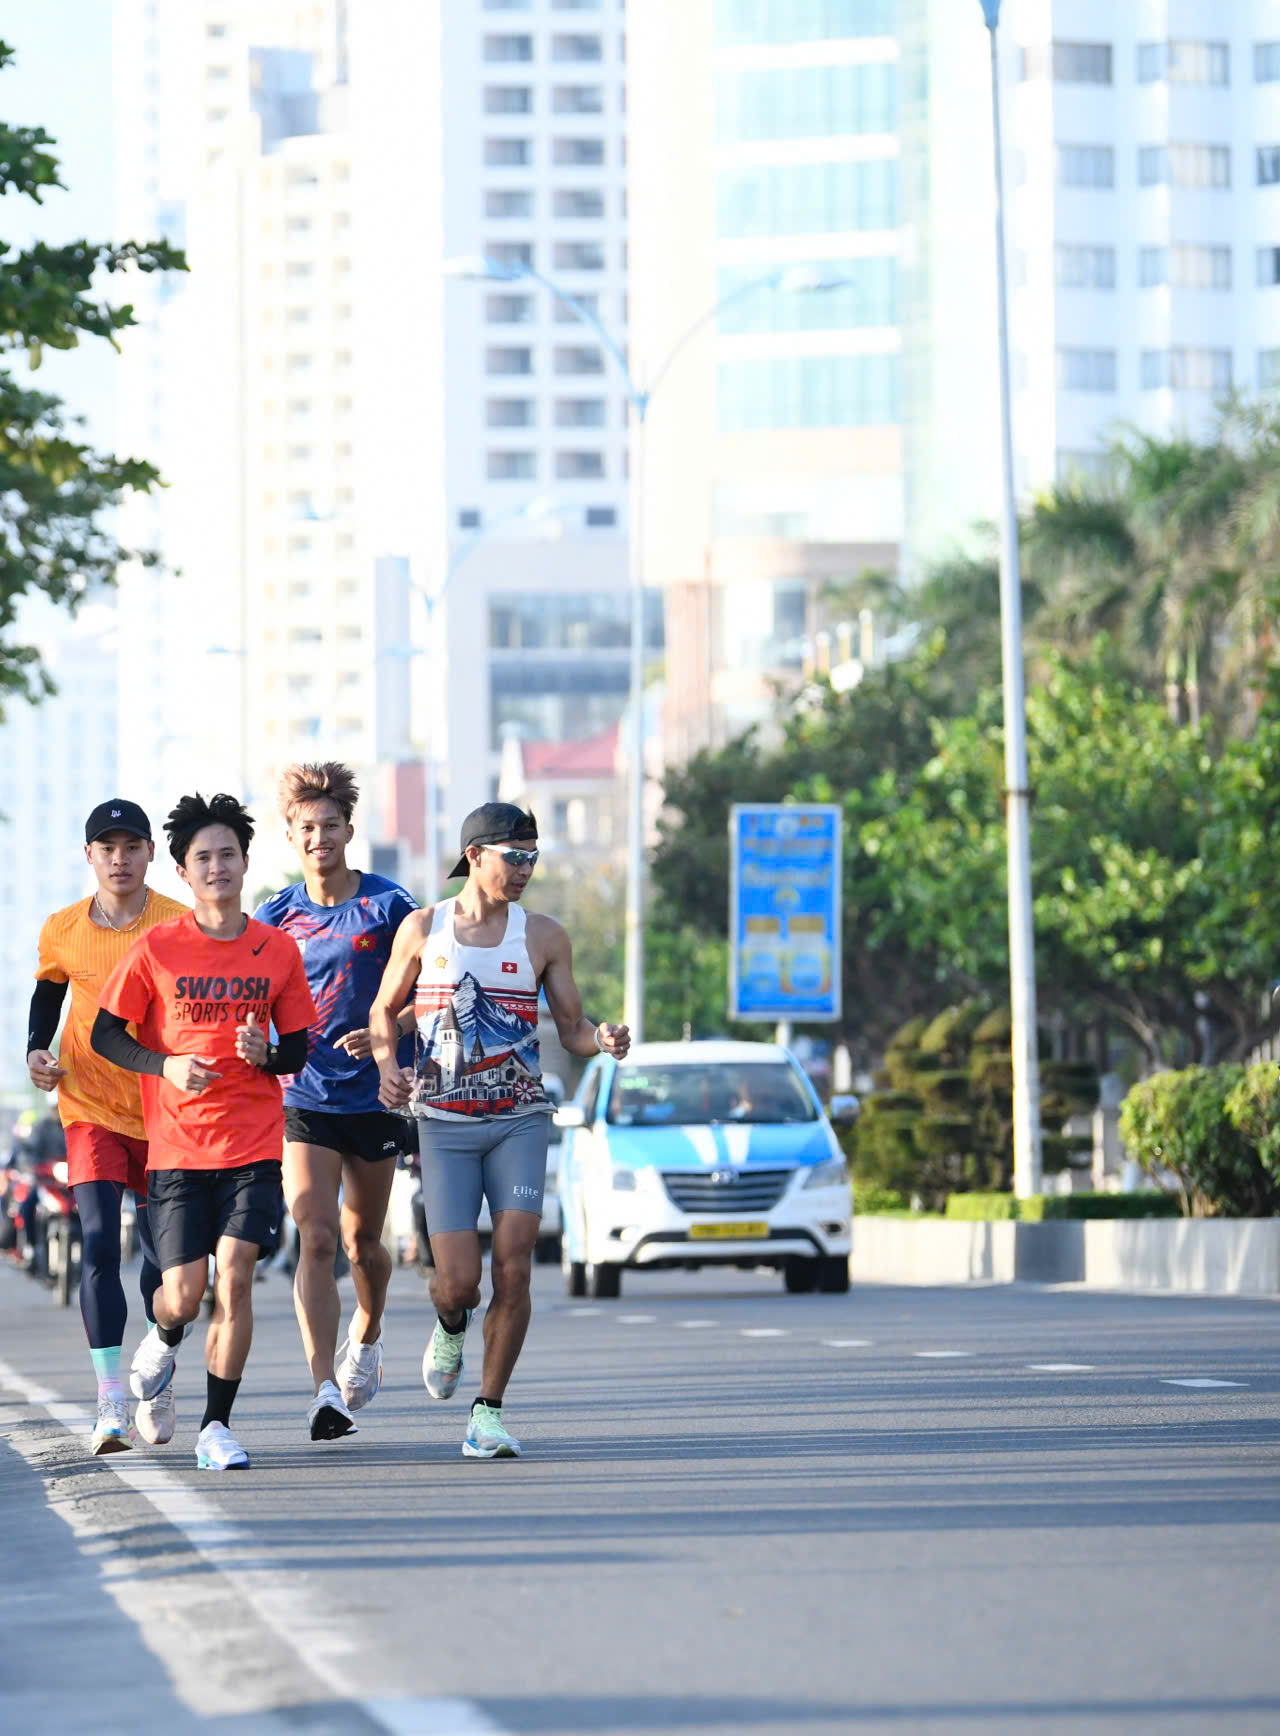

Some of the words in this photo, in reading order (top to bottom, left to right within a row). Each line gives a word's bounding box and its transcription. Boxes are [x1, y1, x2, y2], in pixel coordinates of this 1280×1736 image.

[175, 976, 271, 1001] SWOOSH
[175, 1002, 231, 1023] SPORTS
[235, 1002, 270, 1023] CLUB
[513, 1185, 539, 1197] Elite
